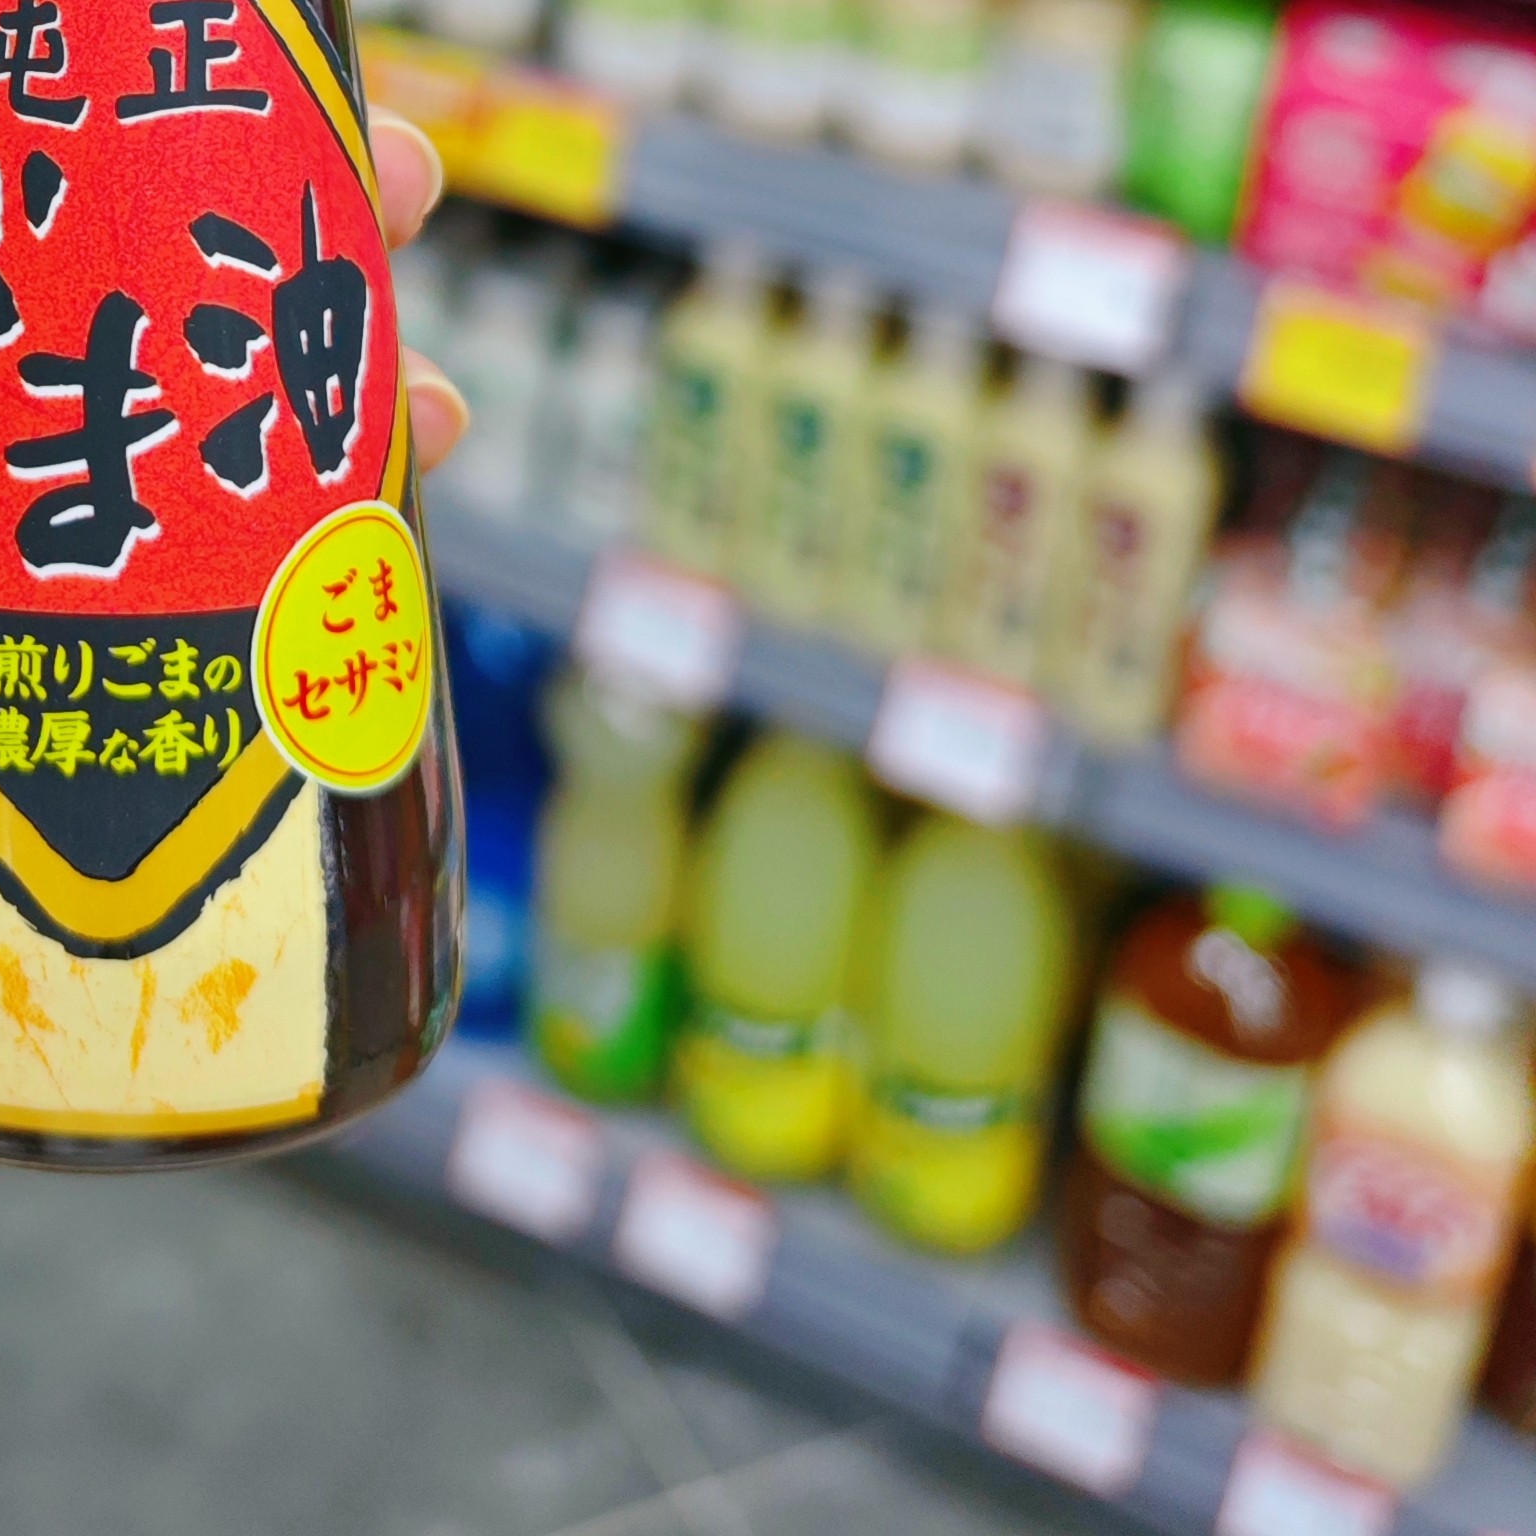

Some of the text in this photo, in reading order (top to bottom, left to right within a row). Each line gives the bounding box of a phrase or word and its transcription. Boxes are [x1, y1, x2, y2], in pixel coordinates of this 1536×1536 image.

[321, 557, 400, 635] ごま
[282, 629, 423, 722] セサミン
